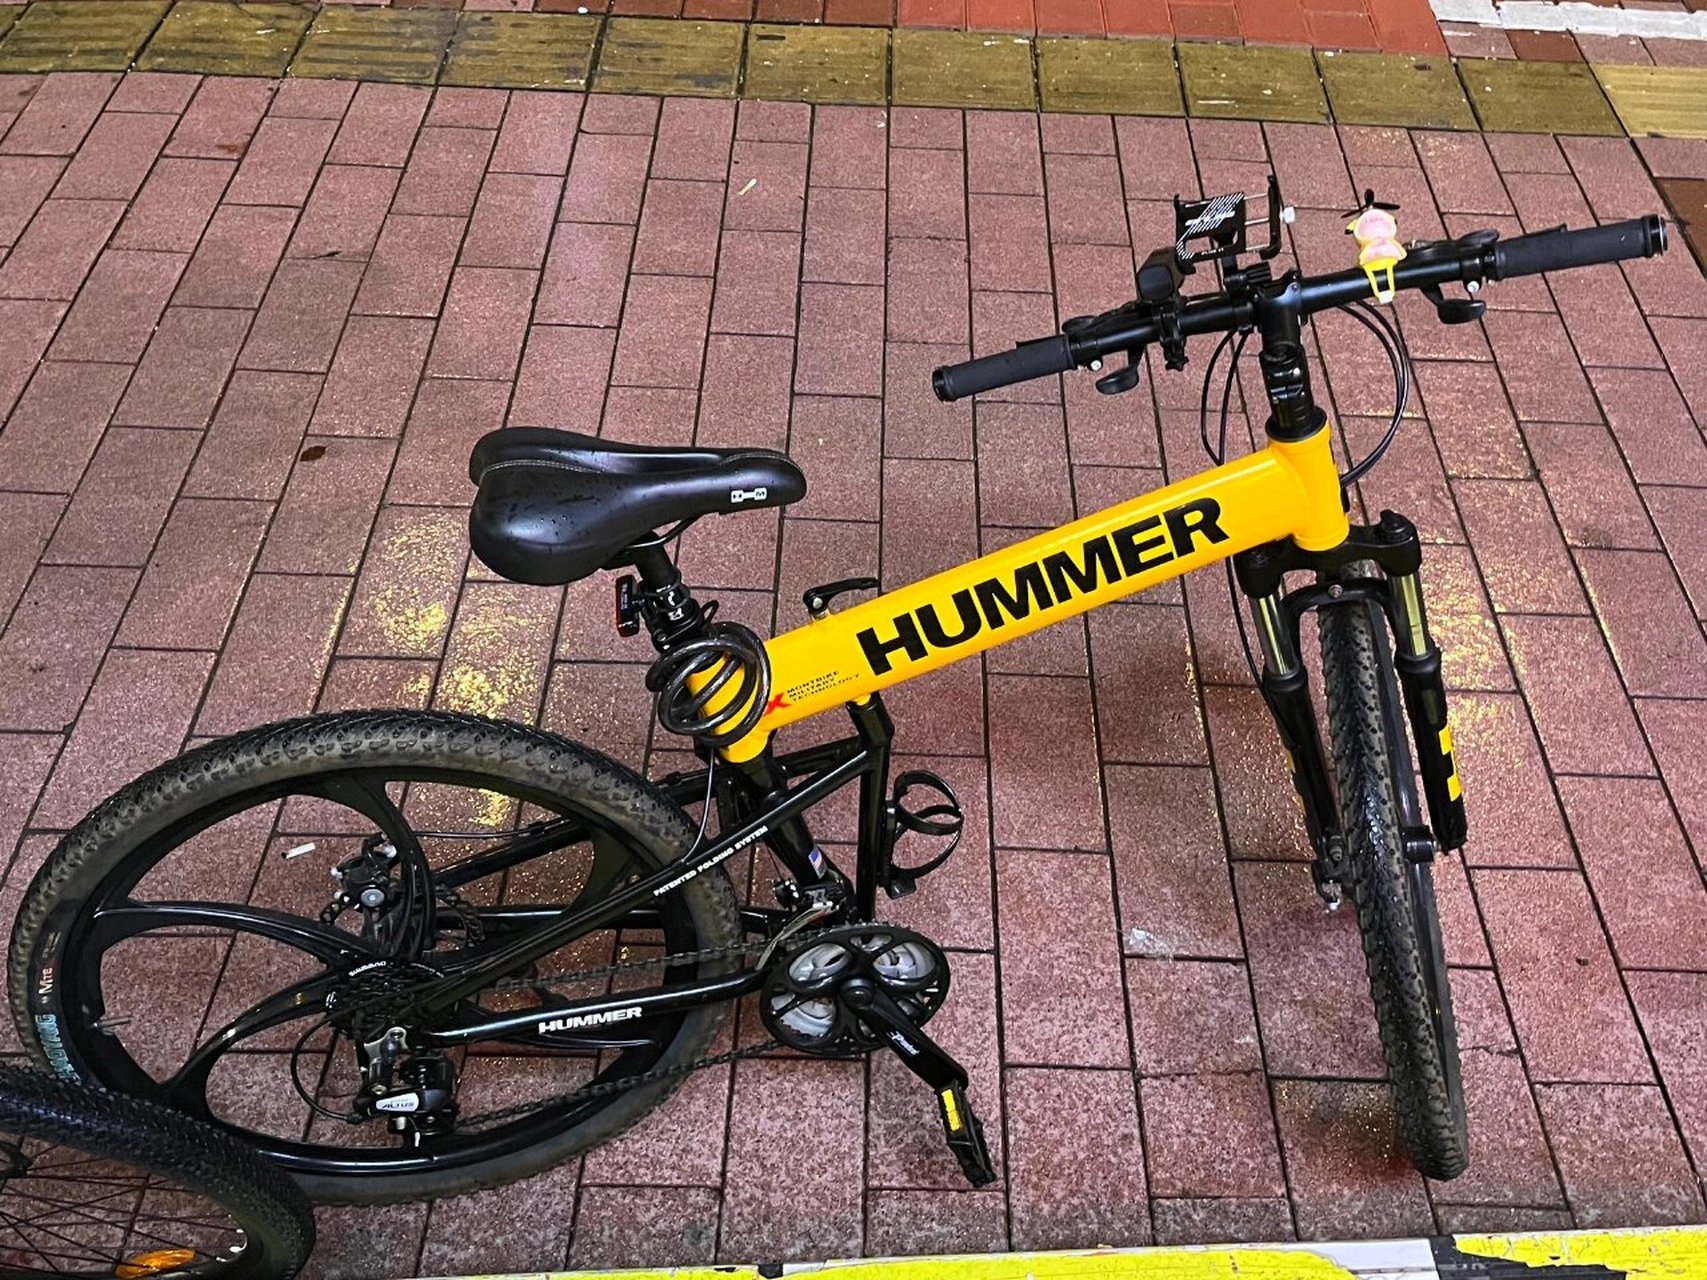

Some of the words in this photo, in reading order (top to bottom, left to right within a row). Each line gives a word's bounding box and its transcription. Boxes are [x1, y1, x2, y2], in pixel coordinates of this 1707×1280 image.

[856, 497, 1230, 676] HUMMER
[788, 677, 835, 698] MILITARY
[792, 672, 860, 702] TECHNOLOGY
[652, 869, 697, 897] PATENTED
[697, 846, 735, 873] FOLDING
[734, 825, 769, 850] SYSTEM
[538, 1006, 643, 1034] HUMMER
